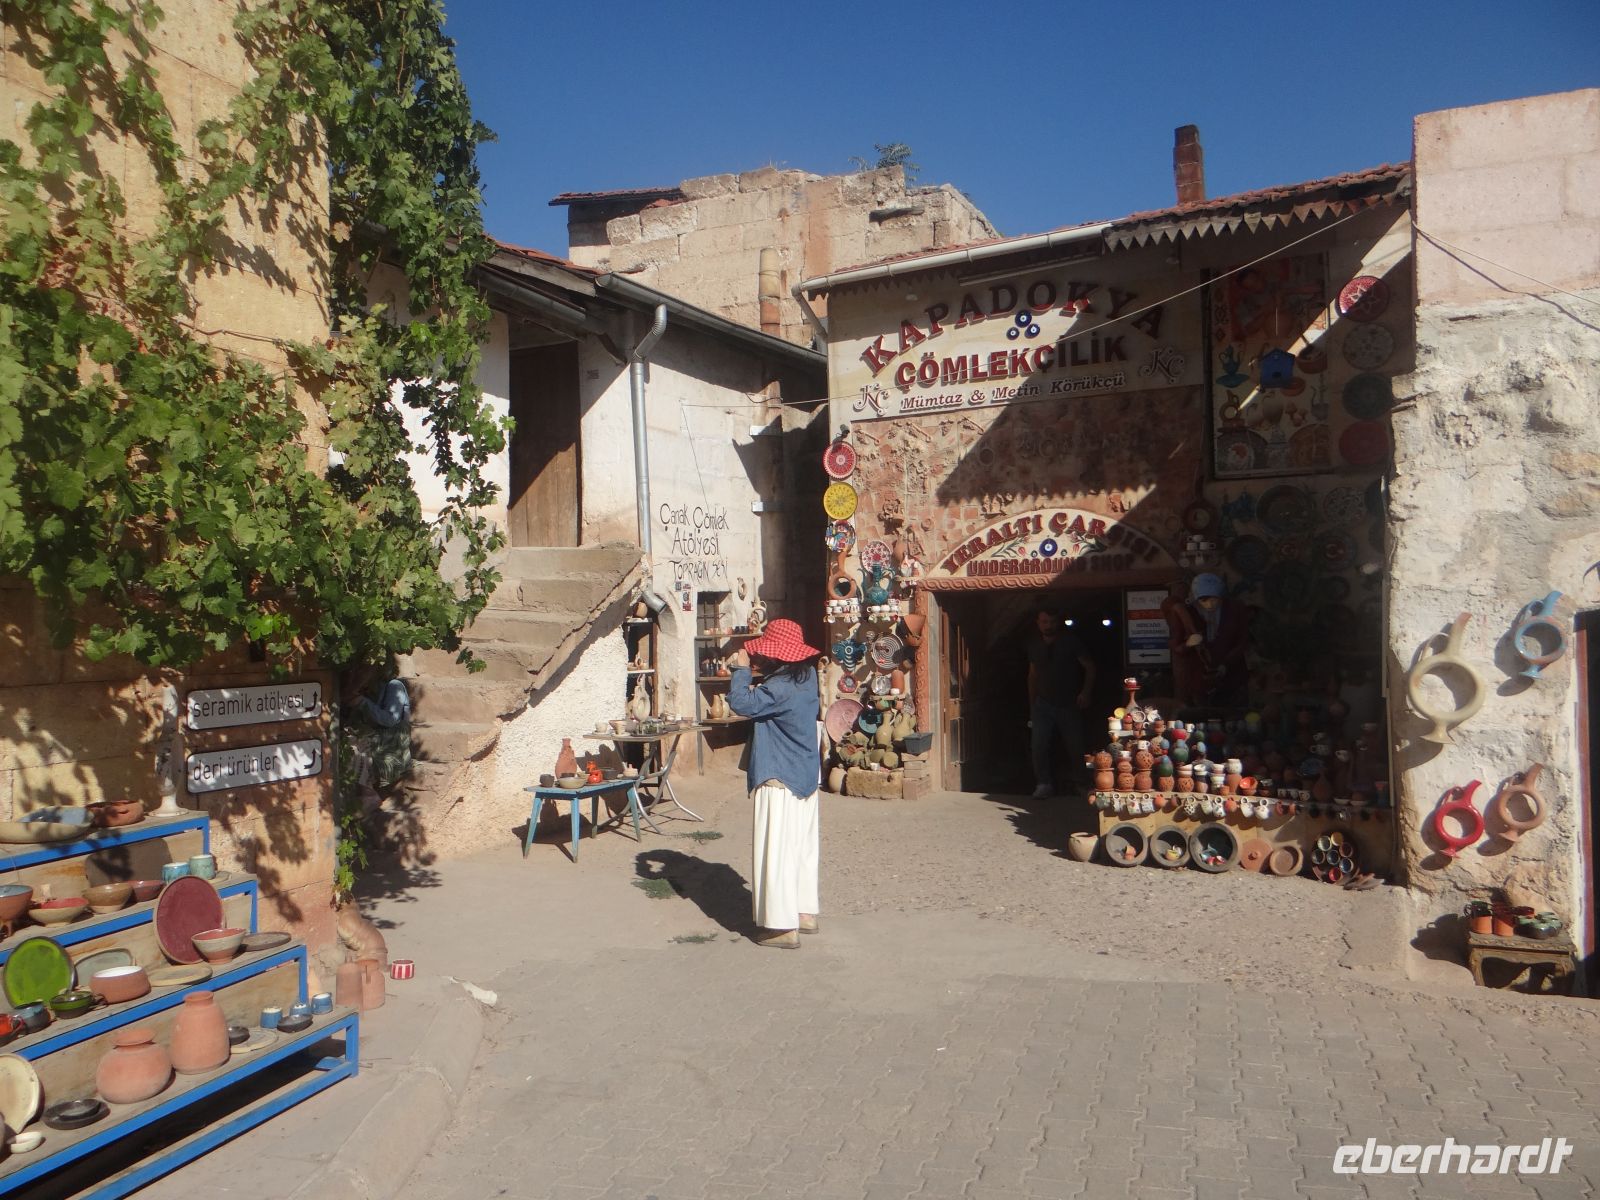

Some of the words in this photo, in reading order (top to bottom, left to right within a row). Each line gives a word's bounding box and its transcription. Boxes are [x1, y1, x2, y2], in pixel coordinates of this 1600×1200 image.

[861, 280, 1169, 377] KAPADOKYA
[897, 332, 1128, 393] ÇÖMLEKÇİLİK
[902, 393, 963, 410] Mümtaz
[970, 389, 986, 403] &
[993, 382, 1041, 400] Metin
[1050, 373, 1126, 394] Körükçü
[660, 503, 690, 532] Çanak
[692, 506, 729, 533] Çömlek
[671, 527, 720, 556] Atölyesi
[940, 514, 1042, 575] YERALTI
[966, 555, 1088, 577] UNDERGROUND
[1091, 553, 1135, 571] SHOP
[193, 693, 252, 718] seramik
[256, 689, 305, 715] atölyesi
[193, 757, 222, 781] deri
[228, 751, 278, 777] ürünler
